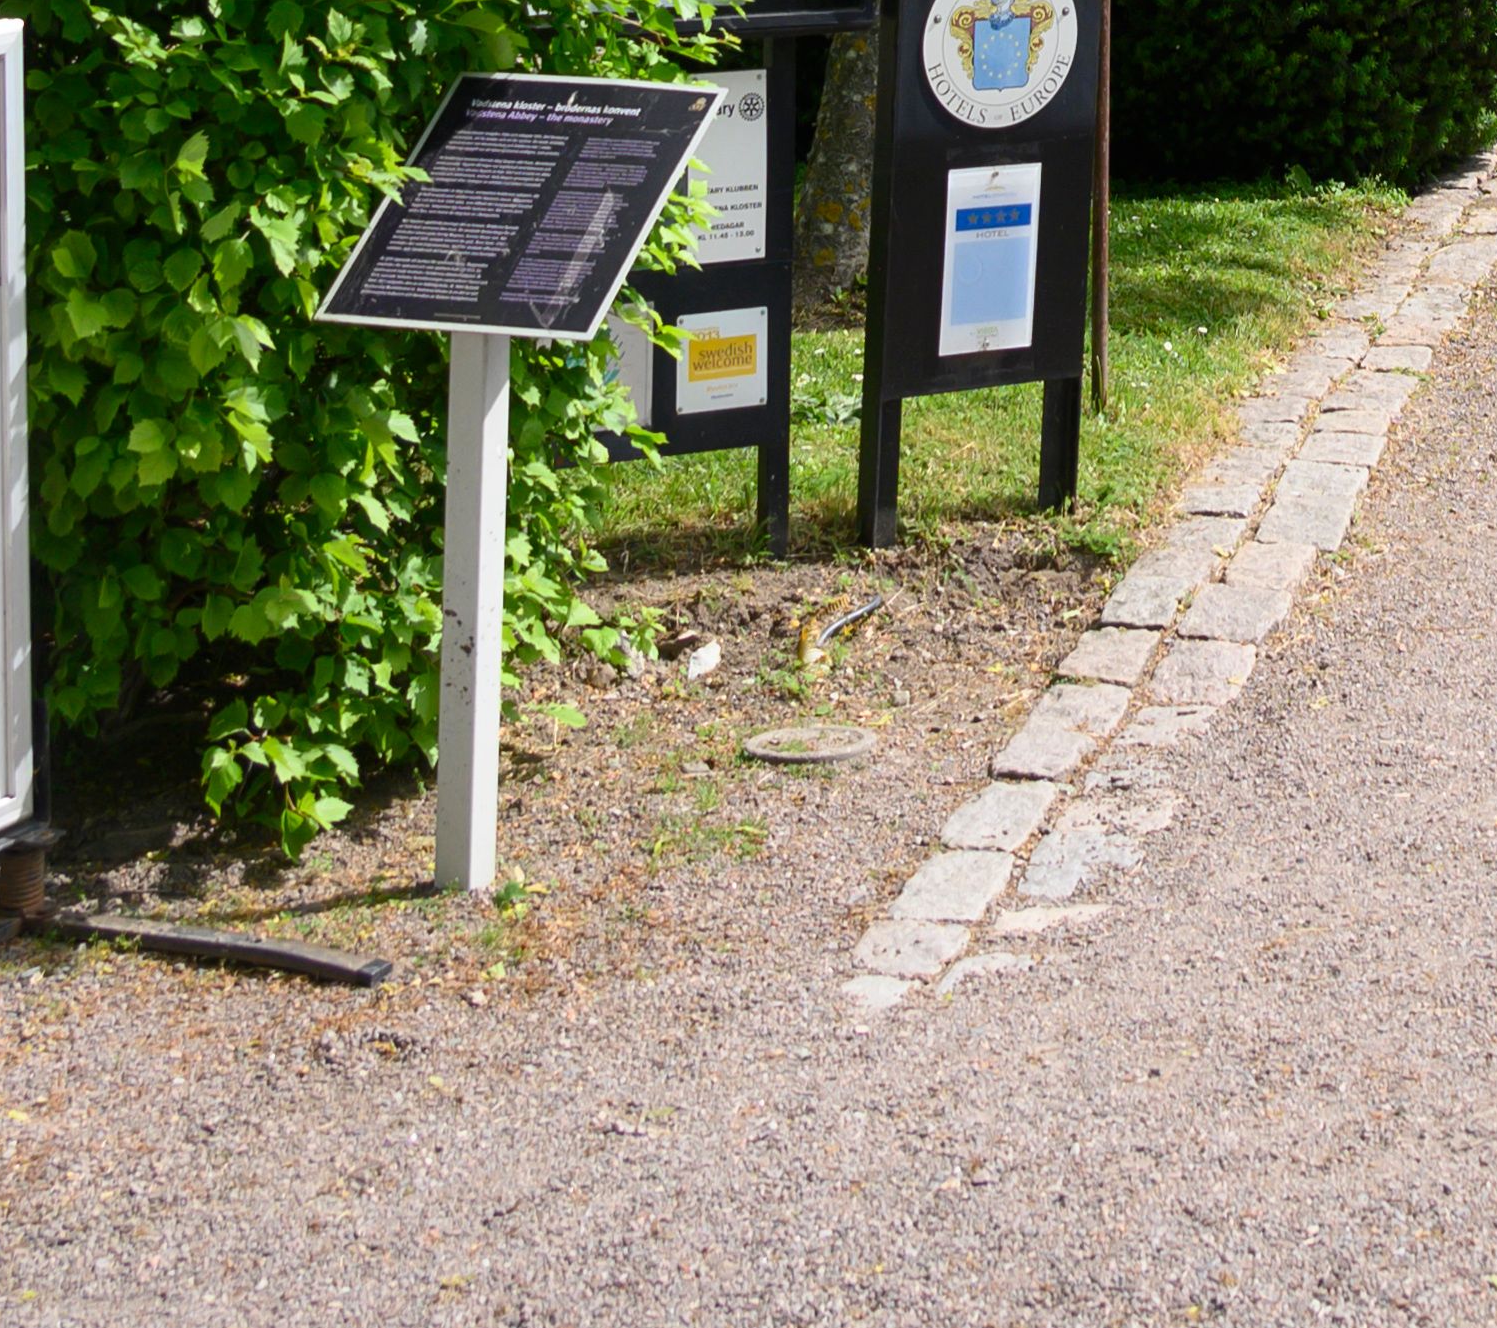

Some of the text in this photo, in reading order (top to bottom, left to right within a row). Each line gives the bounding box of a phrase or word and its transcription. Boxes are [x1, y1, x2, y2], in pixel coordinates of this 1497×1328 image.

[928, 62, 988, 125] HOTELS
[1009, 53, 1071, 123] EUROPE
[513, 98, 545, 111] kloster
[603, 105, 641, 117] konvent
[508, 112, 538, 123] Abbey
[546, 112, 562, 122] the
[563, 115, 614, 127] monastery
[725, 184, 759, 193] KLUBBEN
[730, 202, 763, 211] KLOSTER
[711, 221, 745, 231] REDAGAR
[975, 229, 1010, 238] HOTEL
[699, 341, 753, 359] swedish
[693, 355, 752, 371] welcome
